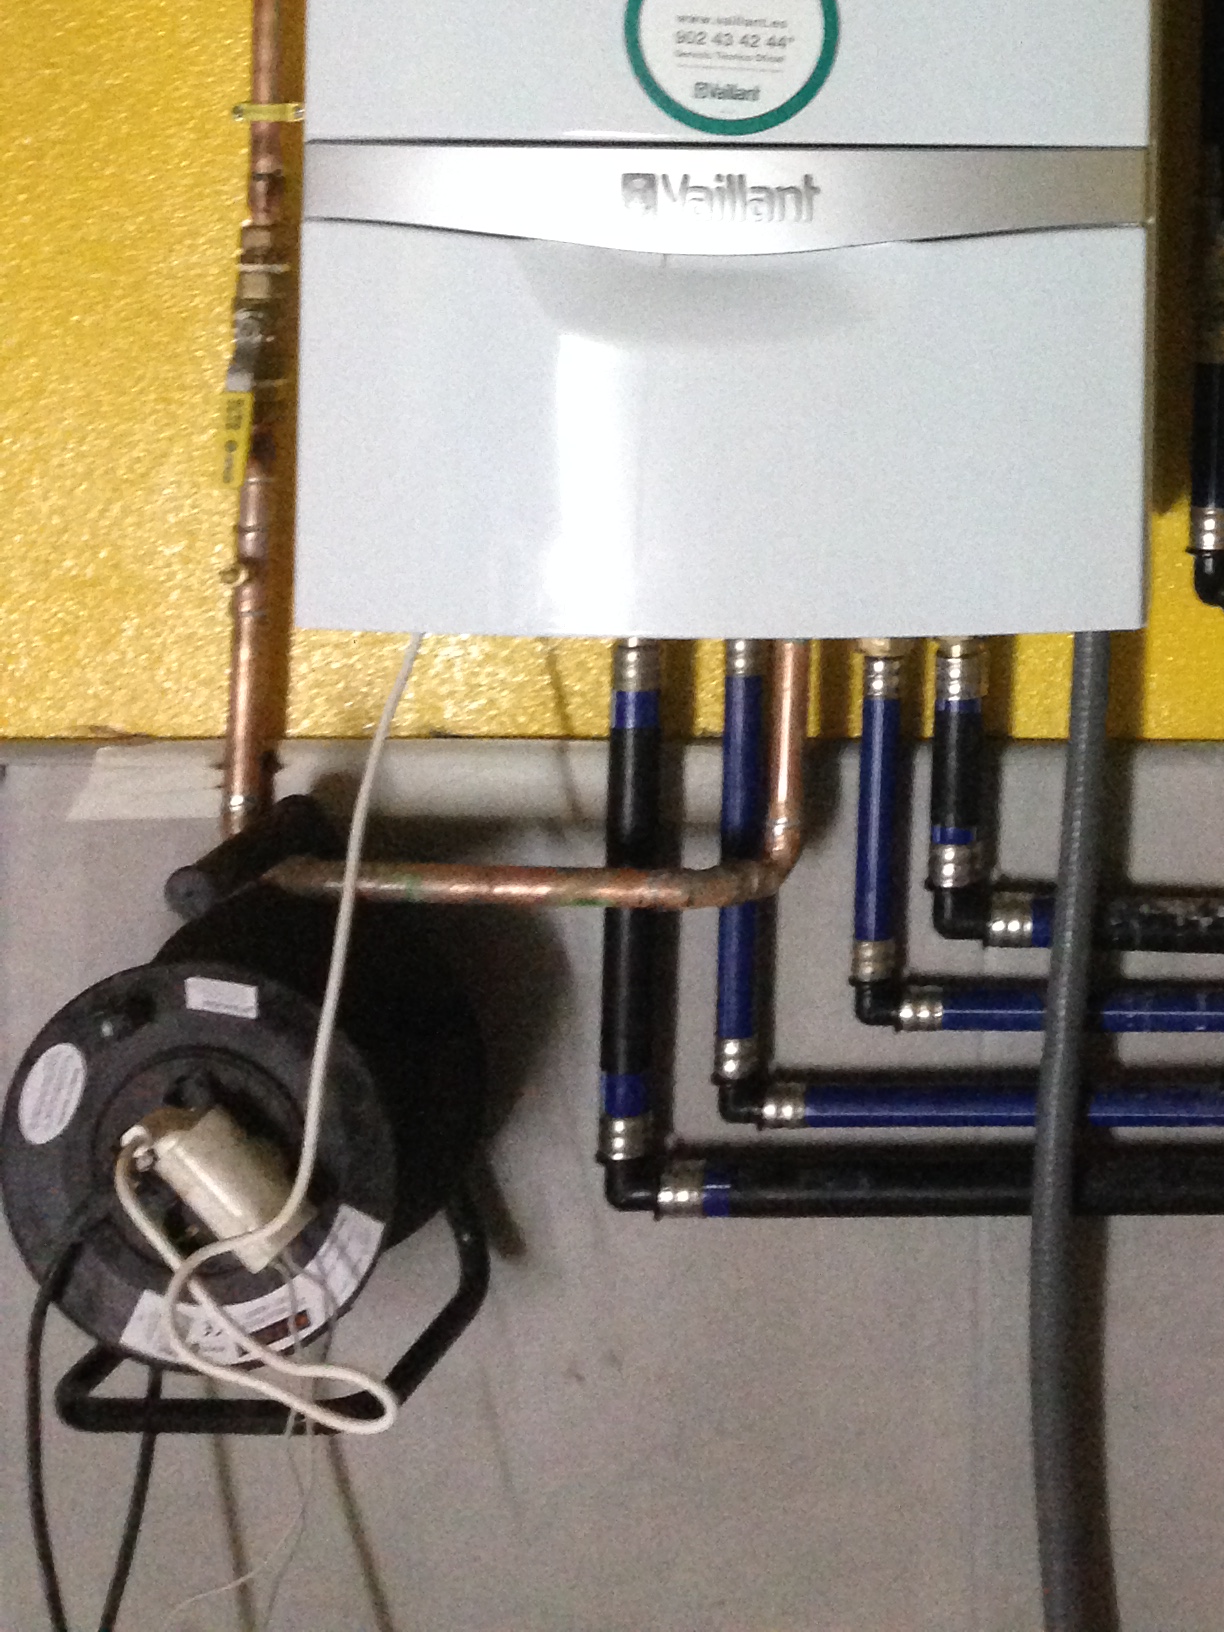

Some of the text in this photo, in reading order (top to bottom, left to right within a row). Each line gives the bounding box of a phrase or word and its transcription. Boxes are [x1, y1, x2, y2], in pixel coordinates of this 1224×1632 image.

[677, 15, 788, 28] www.vaillant.es
[674, 30, 707, 45] 902
[711, 32, 734, 47] 43
[739, 33, 761, 48] 42
[708, 83, 760, 102] Vaillant
[660, 173, 821, 222] Vaillant
